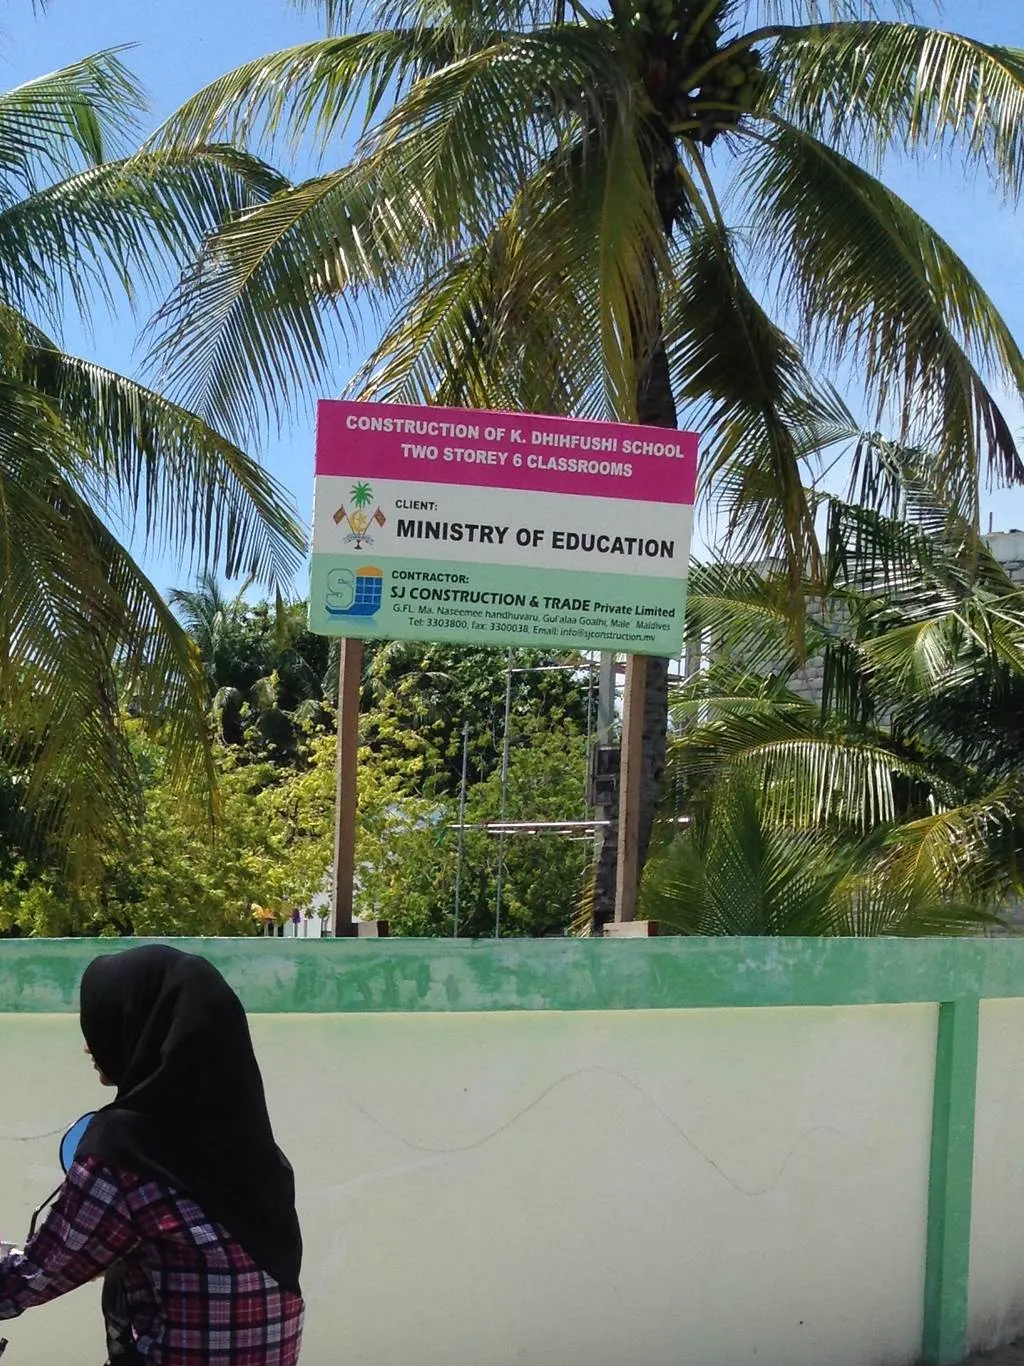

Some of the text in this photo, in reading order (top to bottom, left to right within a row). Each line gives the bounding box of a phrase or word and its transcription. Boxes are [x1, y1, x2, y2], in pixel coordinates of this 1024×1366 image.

[346, 415, 685, 458] CONSTRUCTION OF K. DHIHFUSHI SCHOOL
[401, 443, 633, 477] TWO STOREY 6 CLASSROOMS
[395, 499, 438, 511] CLIENT:
[397, 519, 675, 558] MINISTRY OF EDUCATION
[391, 570, 470, 584] CONTRACTOR:
[390, 586, 676, 618] SJ CONSTRUCTION & TRADE Private Limited
